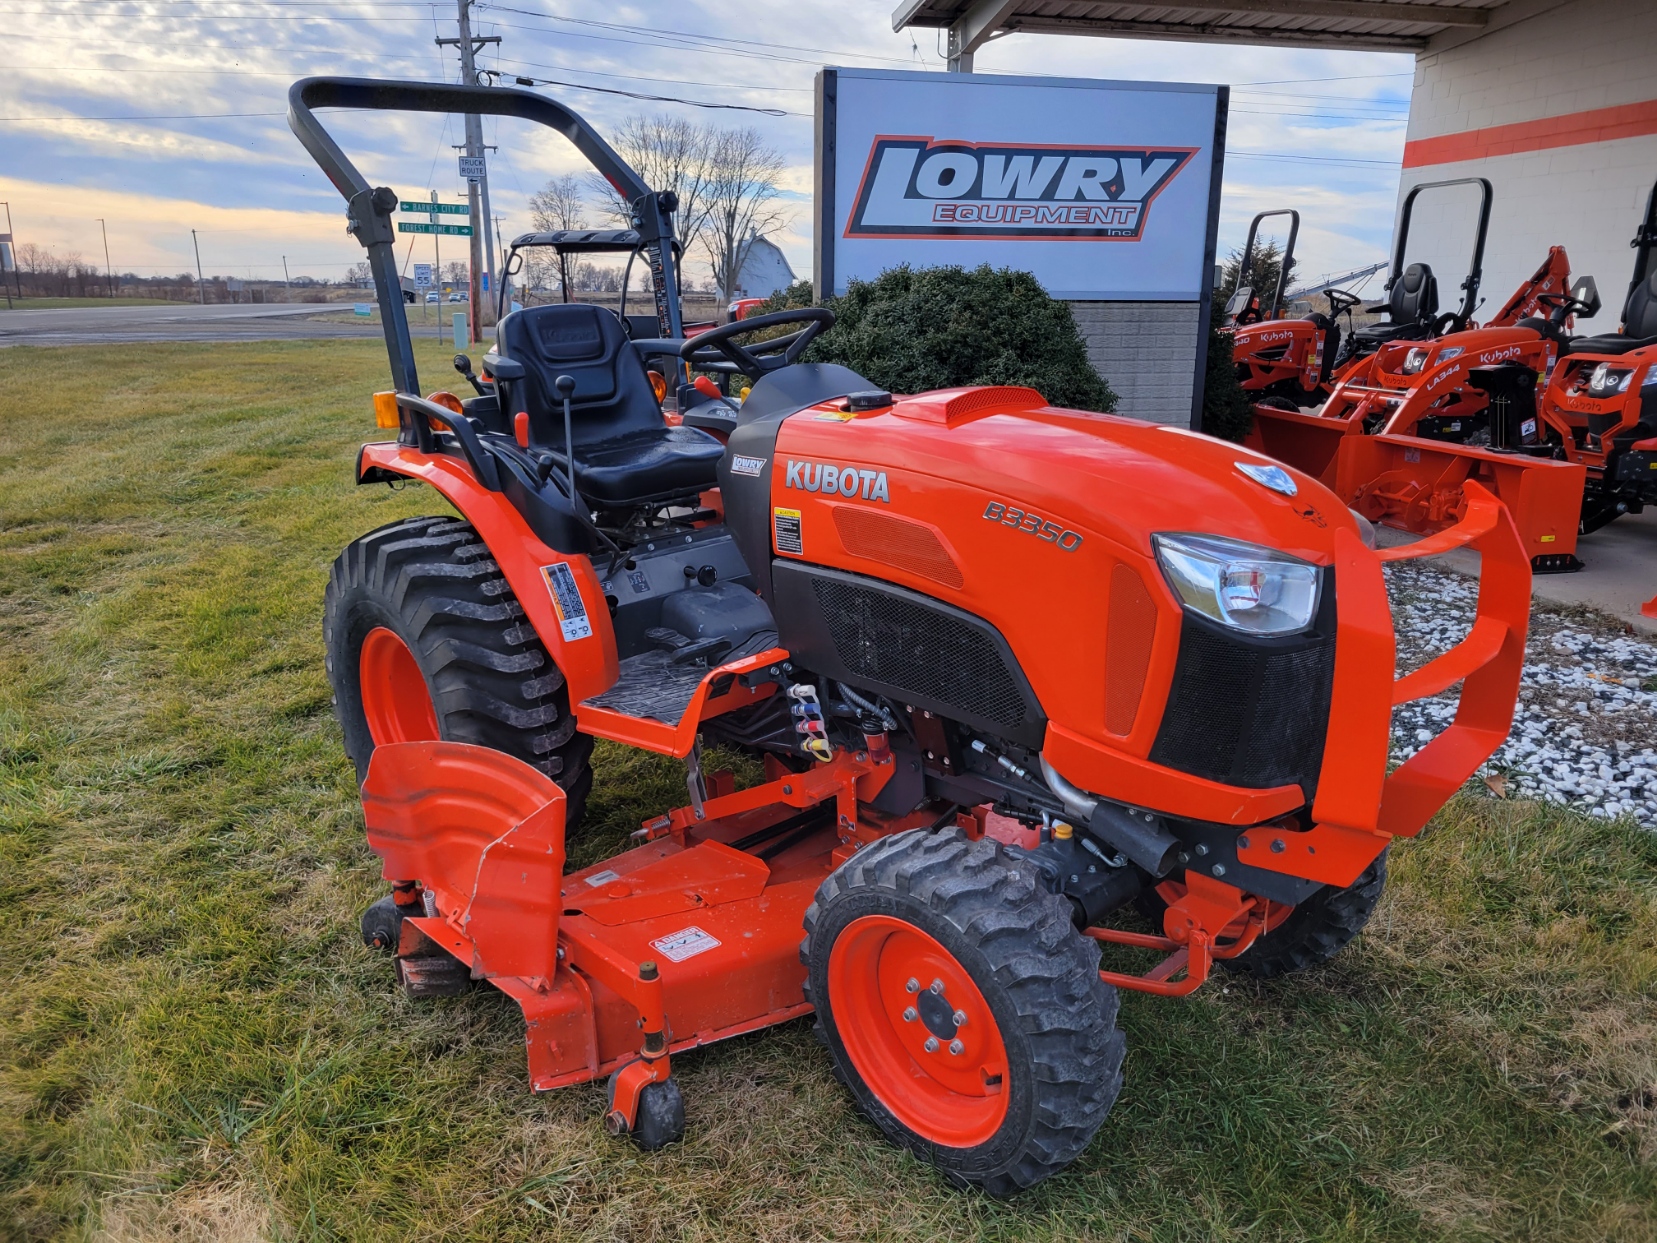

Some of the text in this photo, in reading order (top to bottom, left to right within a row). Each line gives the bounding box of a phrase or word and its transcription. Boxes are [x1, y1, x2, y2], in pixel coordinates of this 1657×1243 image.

[461, 158, 483, 166] TRUCK
[462, 167, 484, 175] ROUTE
[861, 147, 1177, 226] LOWRY
[412, 203, 468, 214] BARNES CITY RD
[932, 204, 1137, 224] EQUIPMENT
[401, 224, 459, 234] FOREST HOME RD
[1107, 228, 1136, 236] Inc.
[417, 276, 430, 285] 55
[1260, 330, 1293, 342] Kubota
[1480, 346, 1521, 364] Kubota
[1384, 374, 1407, 386] Kubota
[1426, 363, 1460, 391] LA344
[1567, 397, 1602, 412] Kubota
[732, 456, 764, 471] LOWRY
[785, 459, 890, 503] KUBOTA
[982, 500, 1084, 553] B3350
